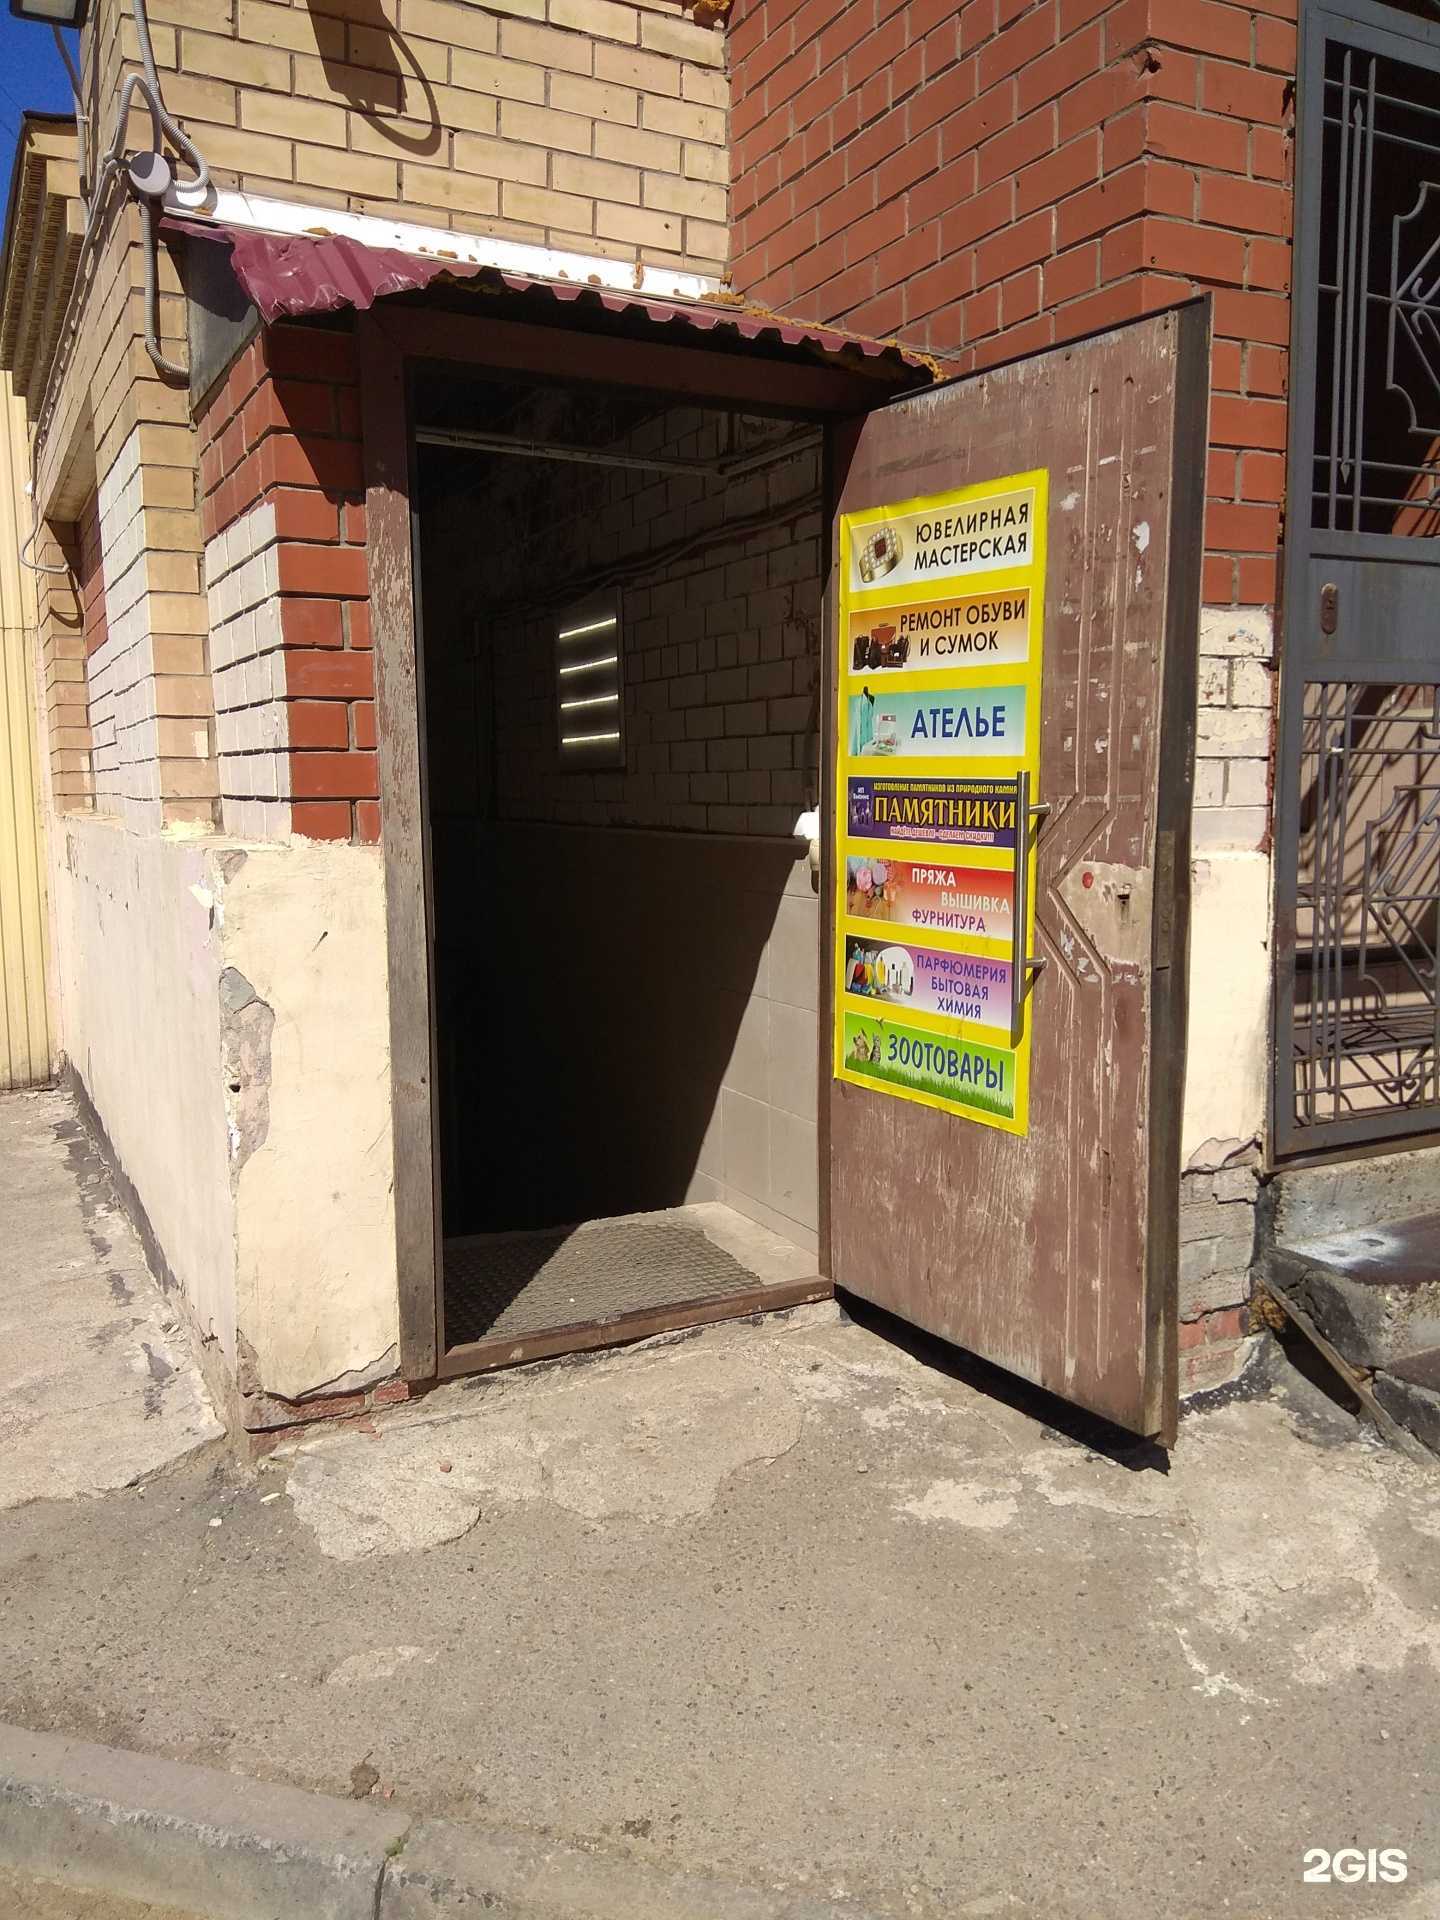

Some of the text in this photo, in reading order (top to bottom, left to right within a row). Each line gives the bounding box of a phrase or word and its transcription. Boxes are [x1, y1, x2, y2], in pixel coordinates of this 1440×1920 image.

[916, 502, 1029, 544] ЮВЕЛИРНАЯ
[914, 532, 1028, 570] МАСТЕРСКАЯ
[900, 599, 1026, 633] РЕМОНТ ОБУВИ
[920, 630, 999, 657] И СУМОК
[911, 705, 1006, 739] АТЕЛЬЕ
[874, 796, 1016, 830] ПАМЯТНИКИ
[911, 867, 957, 887] ПРЯЖА
[940, 891, 1010, 913] ВЫШИВКА
[911, 908, 986, 932] ФУРНИТУРА
[916, 954, 1007, 984] ПАРФЮМЕРИЯ
[931, 976, 989, 1000] БЫТОВАЯ
[937, 996, 982, 1019] ХИМИЯ
[887, 1033, 1004, 1092] ЗООТОВАРЫ
